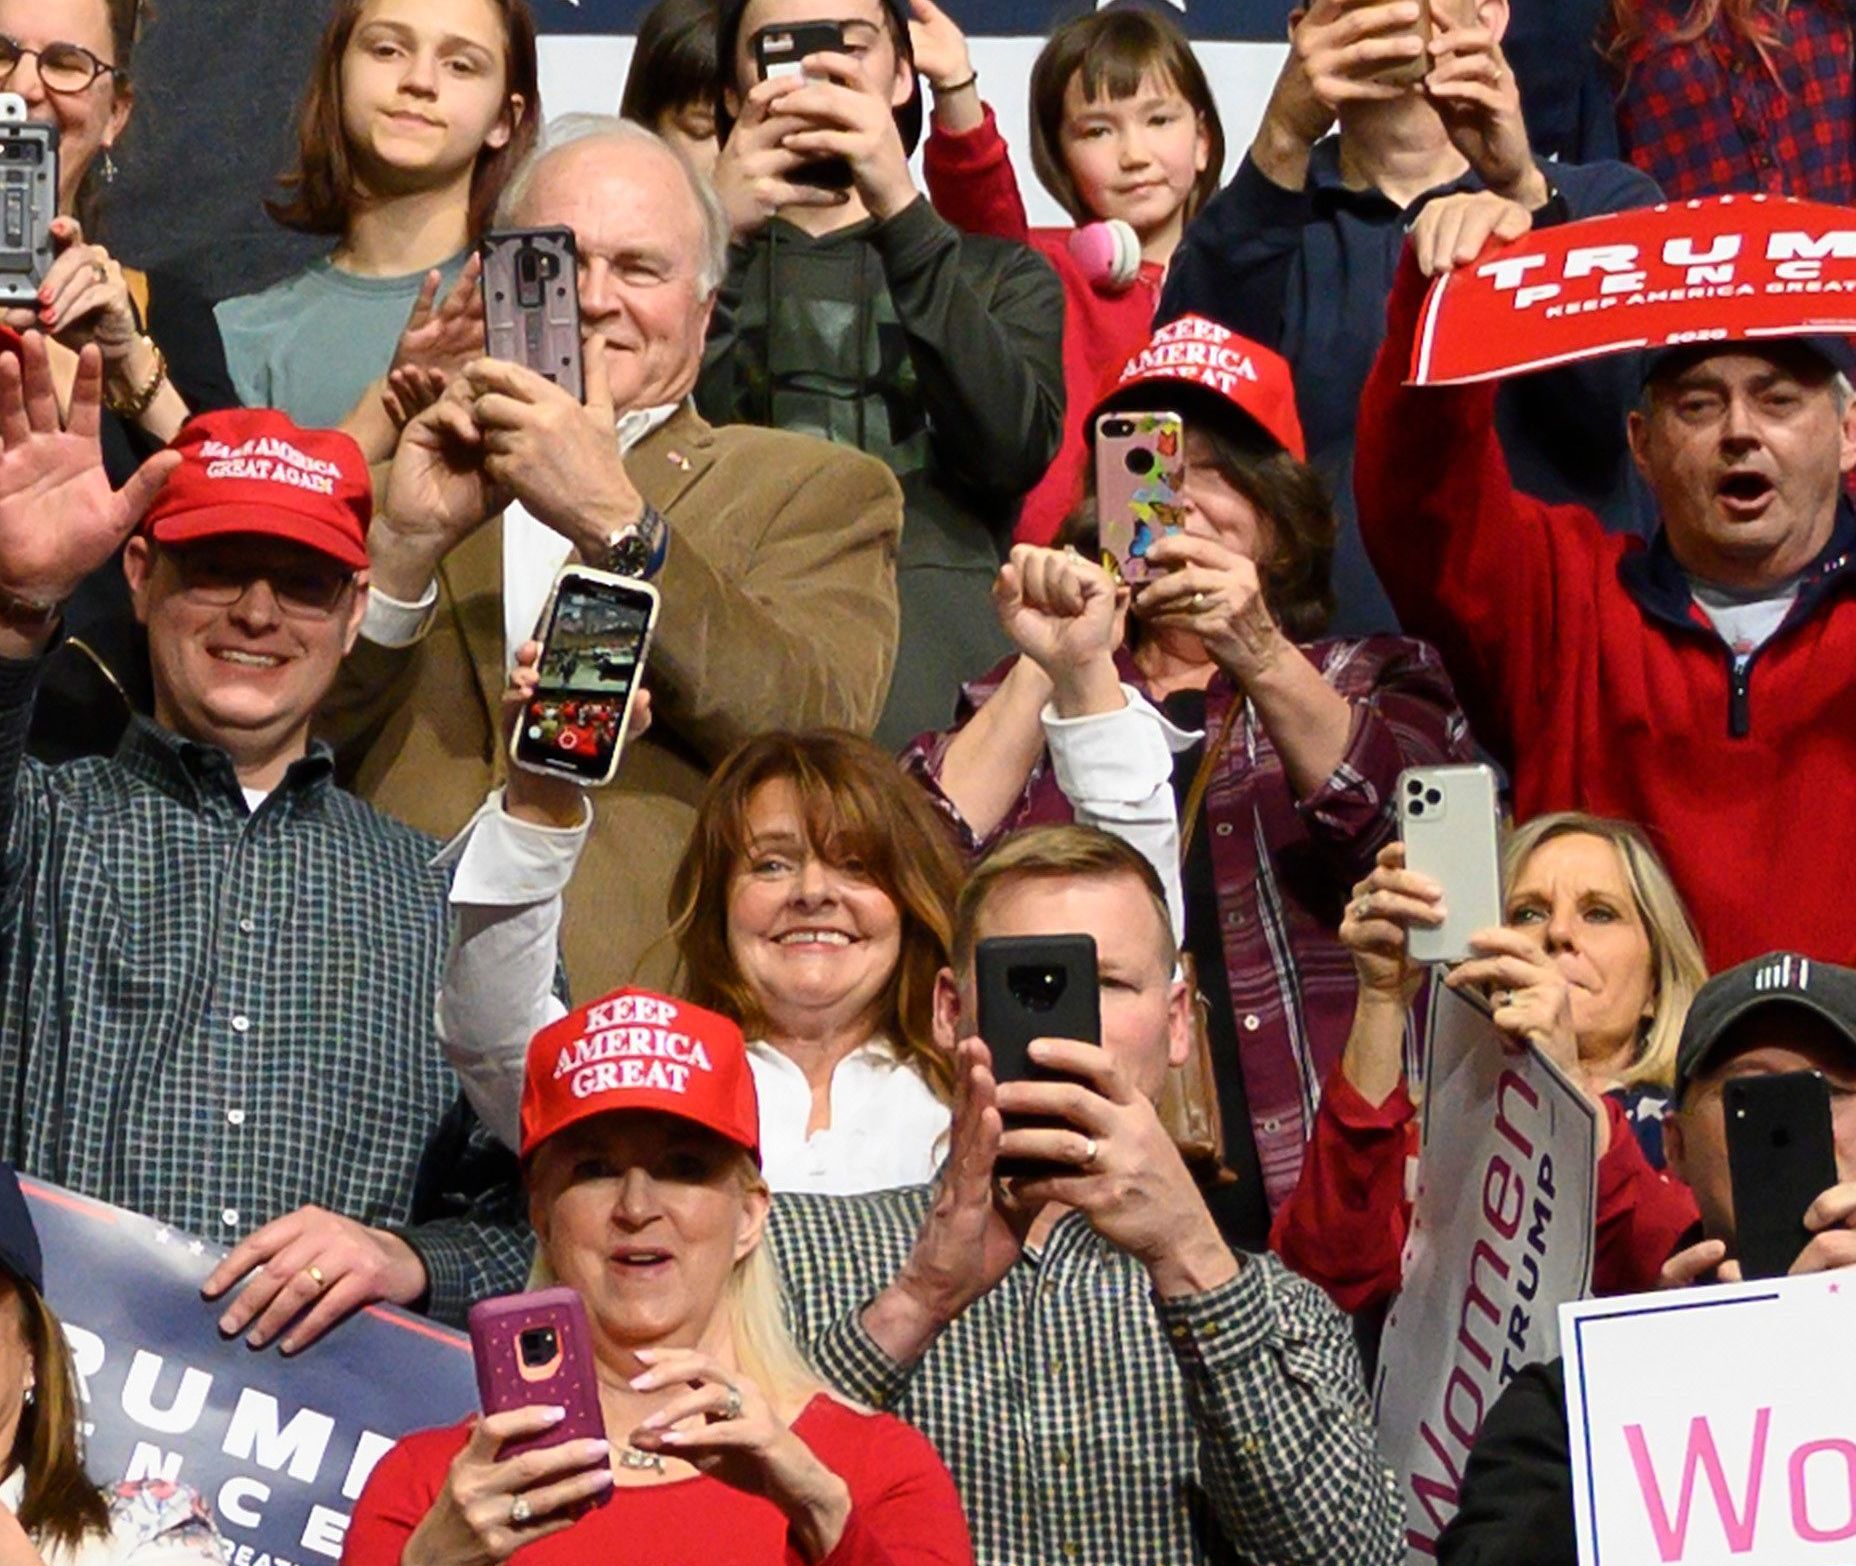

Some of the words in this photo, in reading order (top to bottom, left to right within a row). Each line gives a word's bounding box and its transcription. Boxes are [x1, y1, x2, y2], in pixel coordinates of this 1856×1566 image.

[1545, 298, 1617, 318] KEEP
[1626, 284, 1755, 306] AMERICA
[1150, 316, 1232, 347] KEEP
[1119, 342, 1258, 383] AMERICA
[206, 458, 273, 479] GREAT
[270, 462, 334, 496] AGAIN
[254, 437, 343, 479] AMERICA
[584, 995, 678, 1034] KEEP
[553, 1026, 713, 1080] AMERICA
[571, 1058, 690, 1099] GREAT
[61, 1321, 396, 1501] RUM
[124, 1440, 351, 1561] NCE
